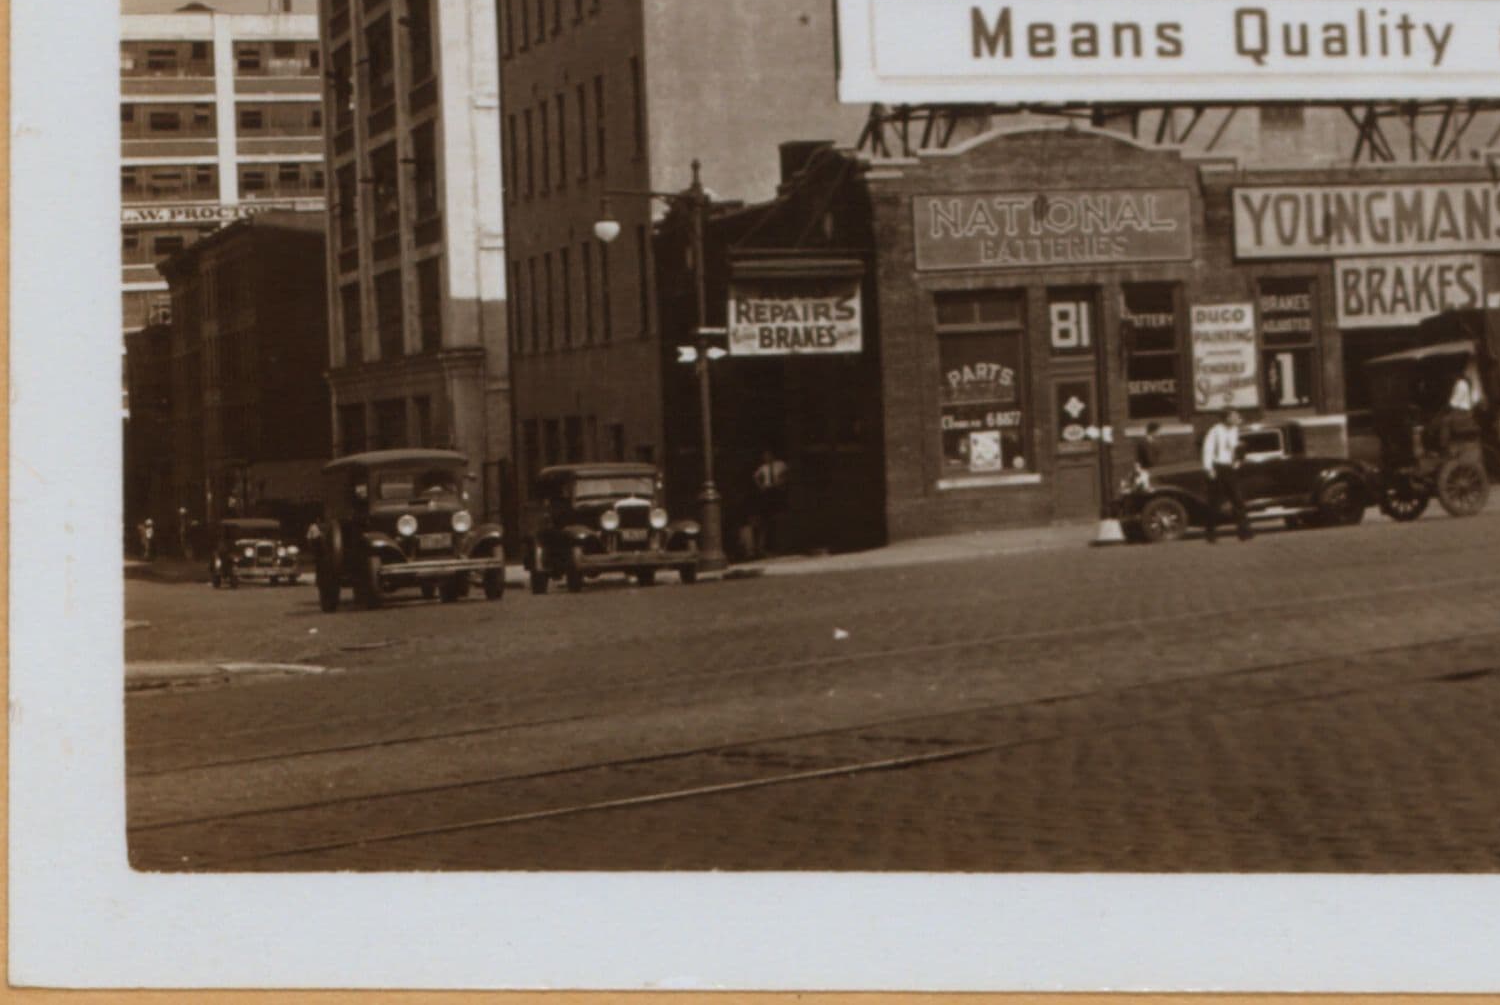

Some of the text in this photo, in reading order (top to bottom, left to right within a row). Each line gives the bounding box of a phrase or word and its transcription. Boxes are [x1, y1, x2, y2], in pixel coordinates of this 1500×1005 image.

[970, 7, 1185, 59] Means
[1234, 7, 1454, 65] Quality
[980, 236, 1130, 265] BATTERIES
[1341, 263, 1480, 318] BRAKES
[735, 299, 857, 325] REPAIRS
[1048, 301, 1092, 348] 81
[1195, 308, 1247, 325] DUCO
[758, 326, 838, 350] BRAKES
[946, 361, 1015, 389] PARTS
[1127, 378, 1176, 395] SERVICE
